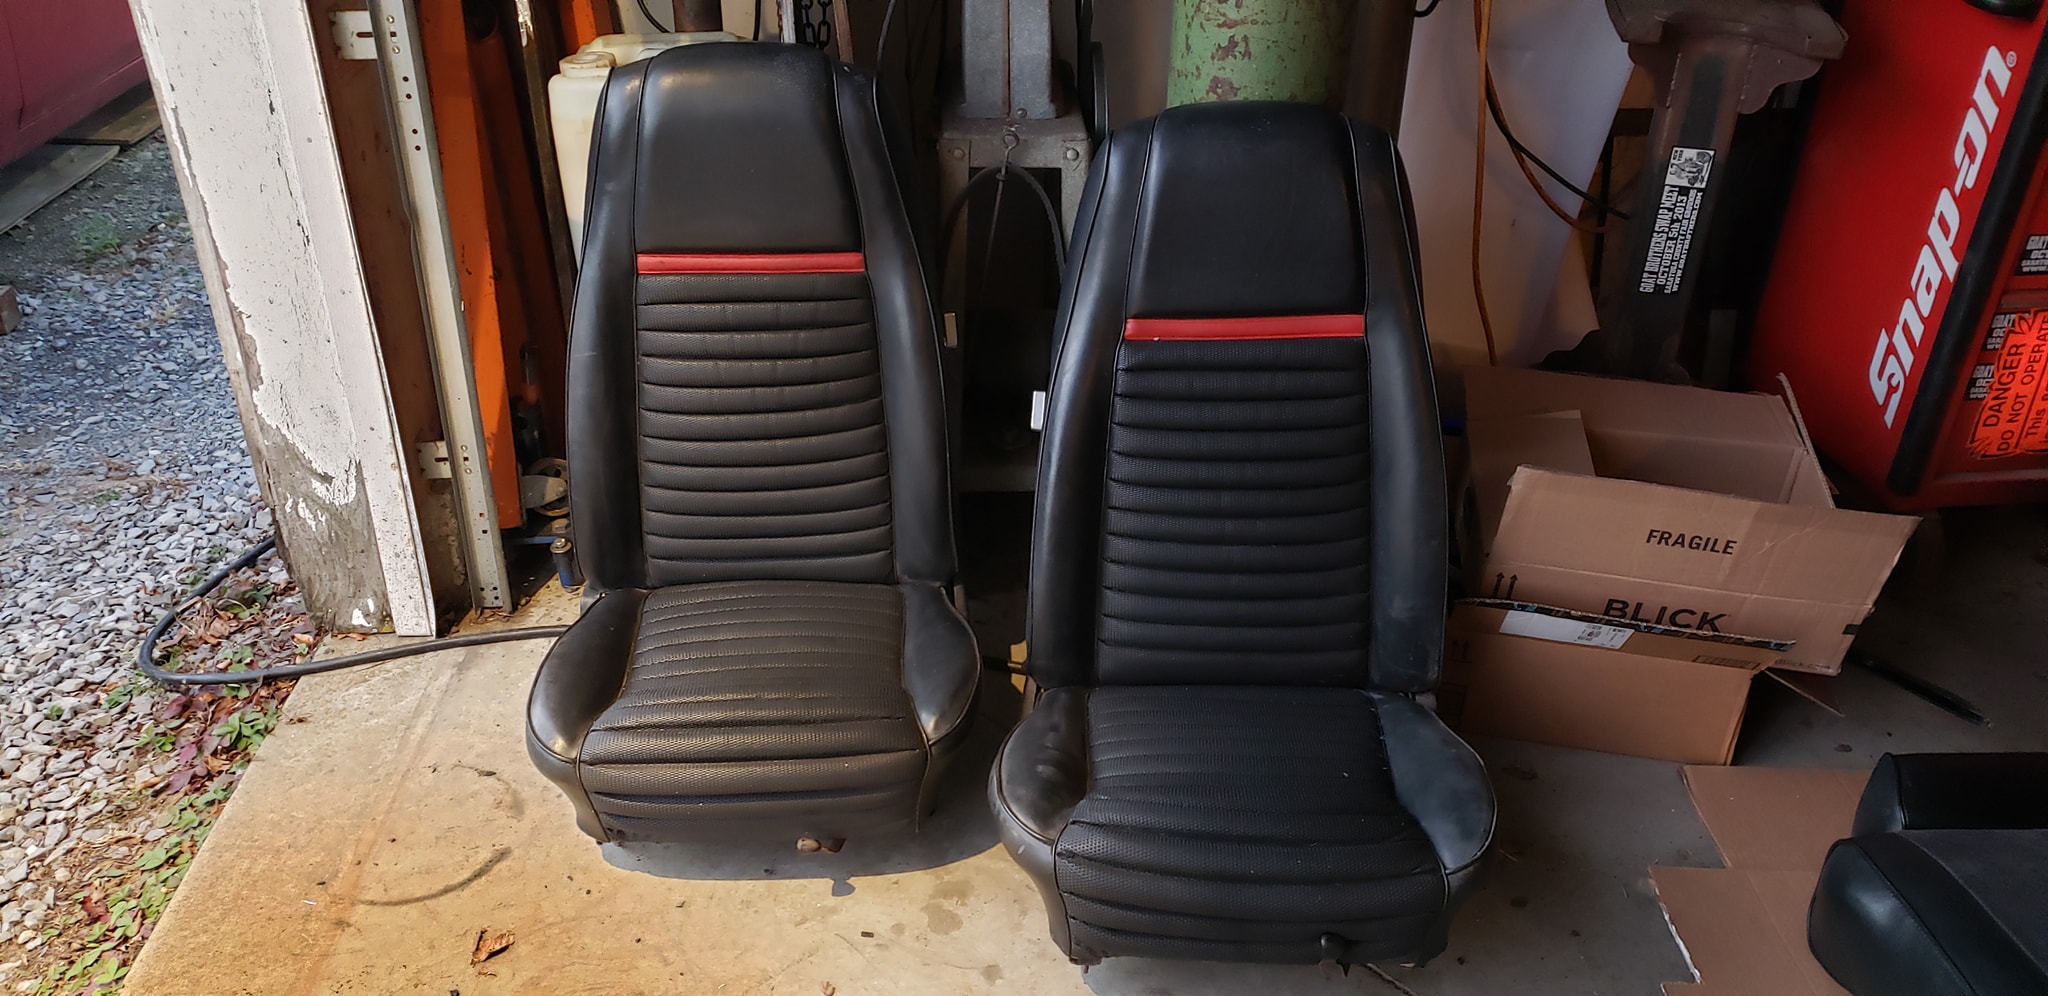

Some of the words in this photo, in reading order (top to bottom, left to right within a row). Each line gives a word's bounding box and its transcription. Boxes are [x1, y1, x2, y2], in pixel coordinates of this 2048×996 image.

[1660, 185, 1680, 209] MEET
[1674, 195, 1687, 221] 2013
[1655, 207, 1673, 233] SWAP
[1668, 220, 1681, 238] 5th
[1644, 232, 1668, 272] BROTHERS
[1868, 45, 2012, 430] Snap-on
[1657, 239, 1677, 285] OCTOBER
[1639, 272, 1657, 293] GOAT
[1982, 342, 2027, 427] DANGER
[1997, 429, 2015, 451] DO
[2009, 392, 2028, 424] NOT
[2020, 314, 2048, 386] OPERATE
[2025, 408, 2046, 439] This
[1645, 528, 1738, 556] FRAGILE
[1602, 598, 1728, 634] BLICK
